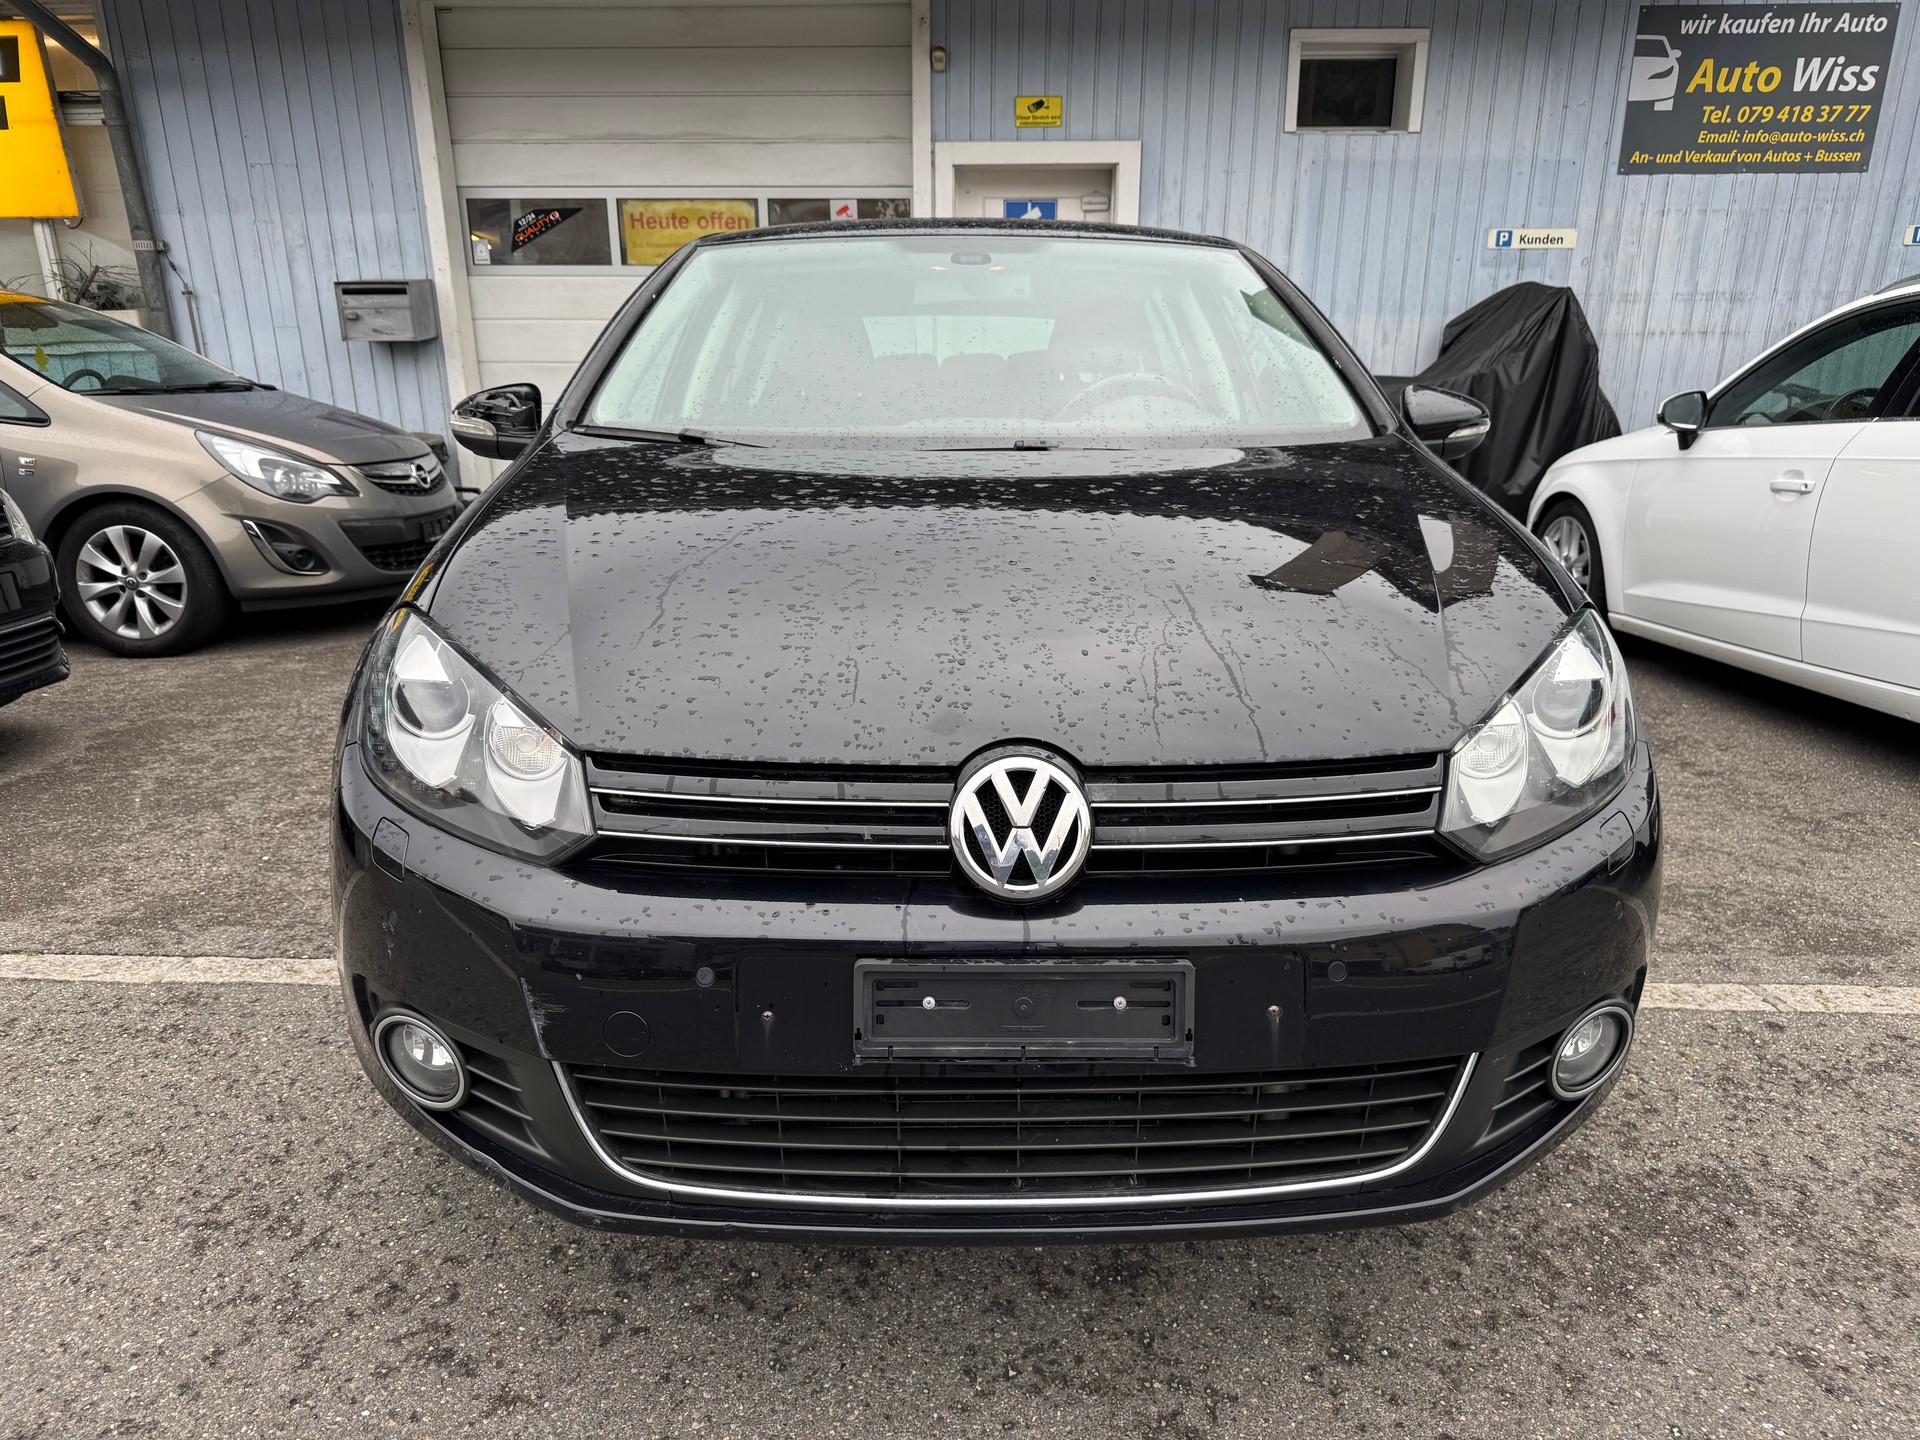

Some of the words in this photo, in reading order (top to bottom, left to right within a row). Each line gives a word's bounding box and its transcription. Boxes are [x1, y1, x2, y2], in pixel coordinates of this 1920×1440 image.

[1680, 13, 1717, 35] wir
[1718, 12, 1796, 34] kaufen
[1798, 12, 1833, 33] Ihr
[1833, 12, 1888, 33] Auto
[1685, 58, 1782, 93] Auto
[1792, 55, 1880, 92] Wiss
[1702, 105, 1732, 124] Tel.
[1736, 105, 1775, 124] 079
[1776, 105, 1815, 123] 418
[1816, 105, 1844, 123] 37
[1844, 105, 1872, 122] 77
[1697, 130, 1741, 144] Email:
[1741, 128, 1866, 145] info@auto-wiss.ch
[1629, 151, 1654, 164] An-
[1655, 150, 1684, 163] und
[1685, 149, 1738, 163] Verkauf
[1736, 152, 1762, 162] von
[1763, 149, 1802, 163] Autos
[1803, 151, 1813, 162] +
[1814, 149, 1861, 163] Bussen
[515, 215, 551, 242] QUALITY
[629, 212, 690, 230] Heute
[696, 211, 749, 230] offen
[1519, 234, 1564, 245] Kunden
